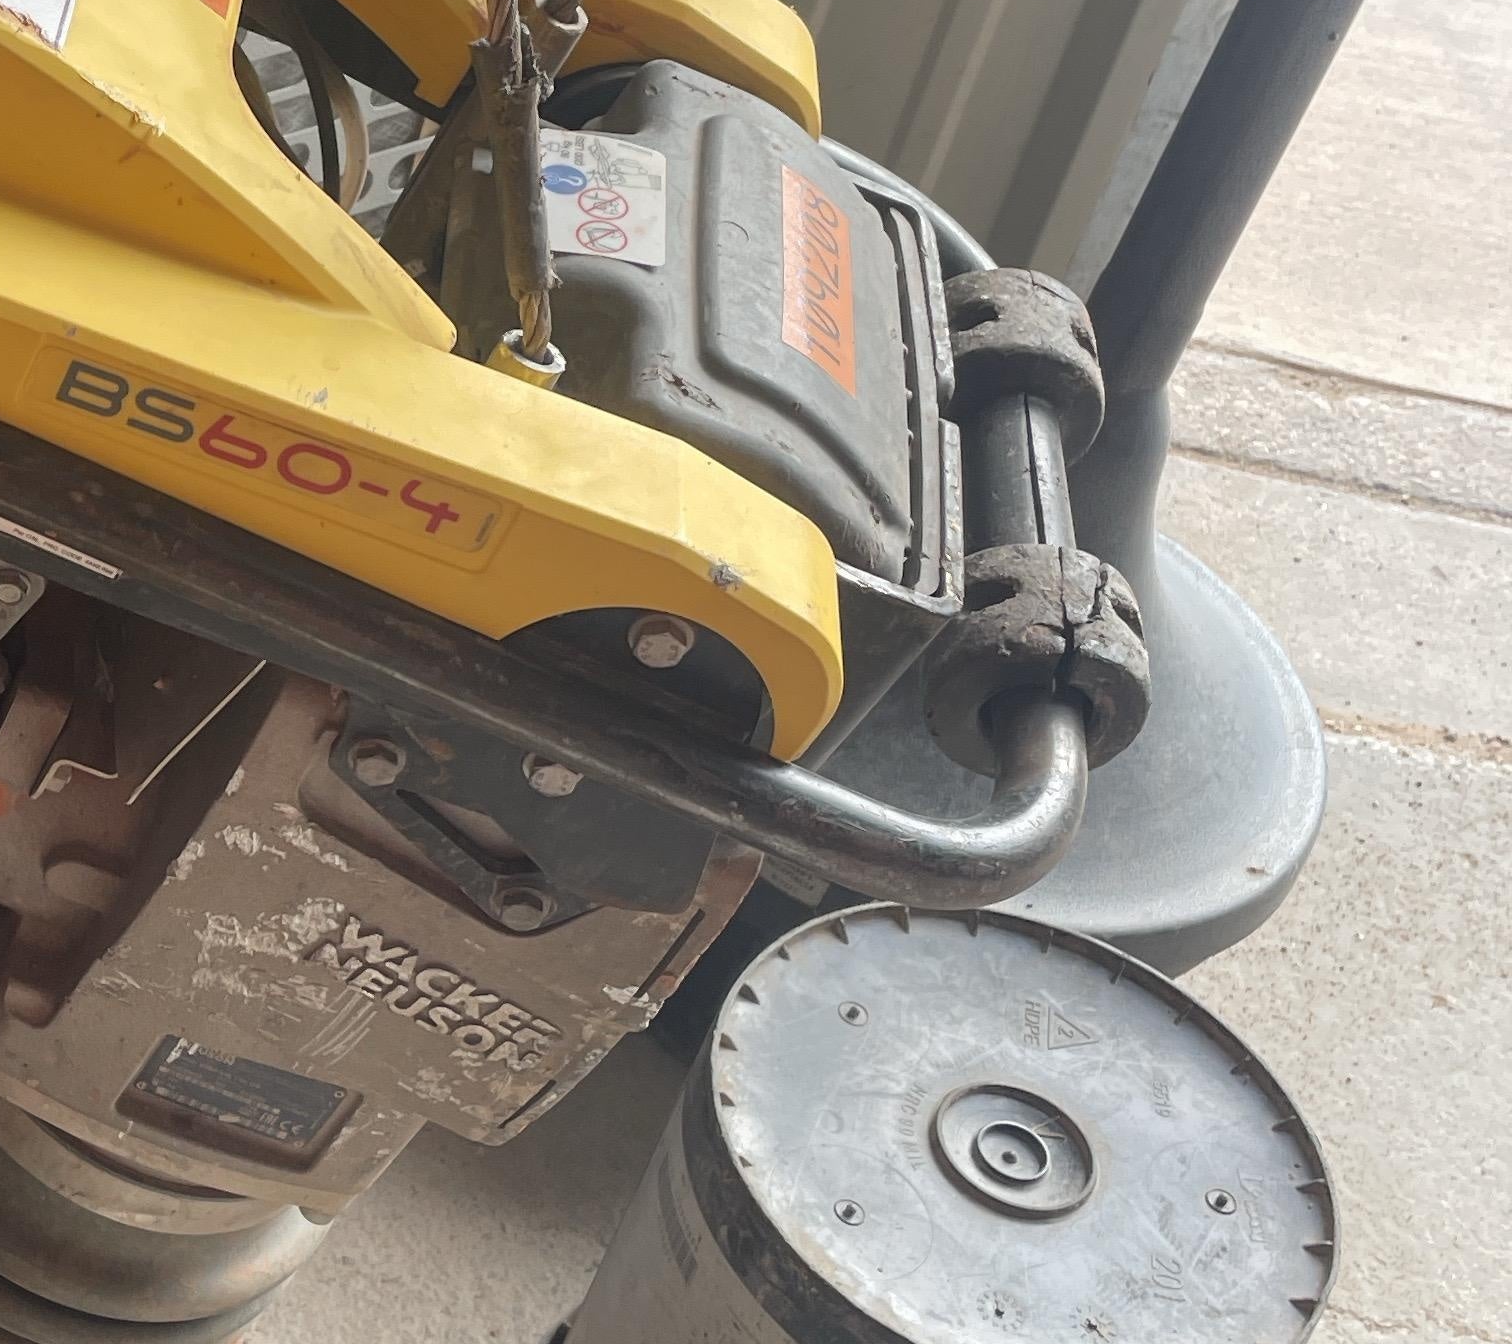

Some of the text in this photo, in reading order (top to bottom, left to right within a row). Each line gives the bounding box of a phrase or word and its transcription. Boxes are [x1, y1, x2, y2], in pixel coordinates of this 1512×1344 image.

[55, 359, 460, 534] BS60-4
[337, 915, 564, 1054] WACKER
[1023, 999, 1040, 1047] HDPE
[1057, 1023, 1074, 1039] 2
